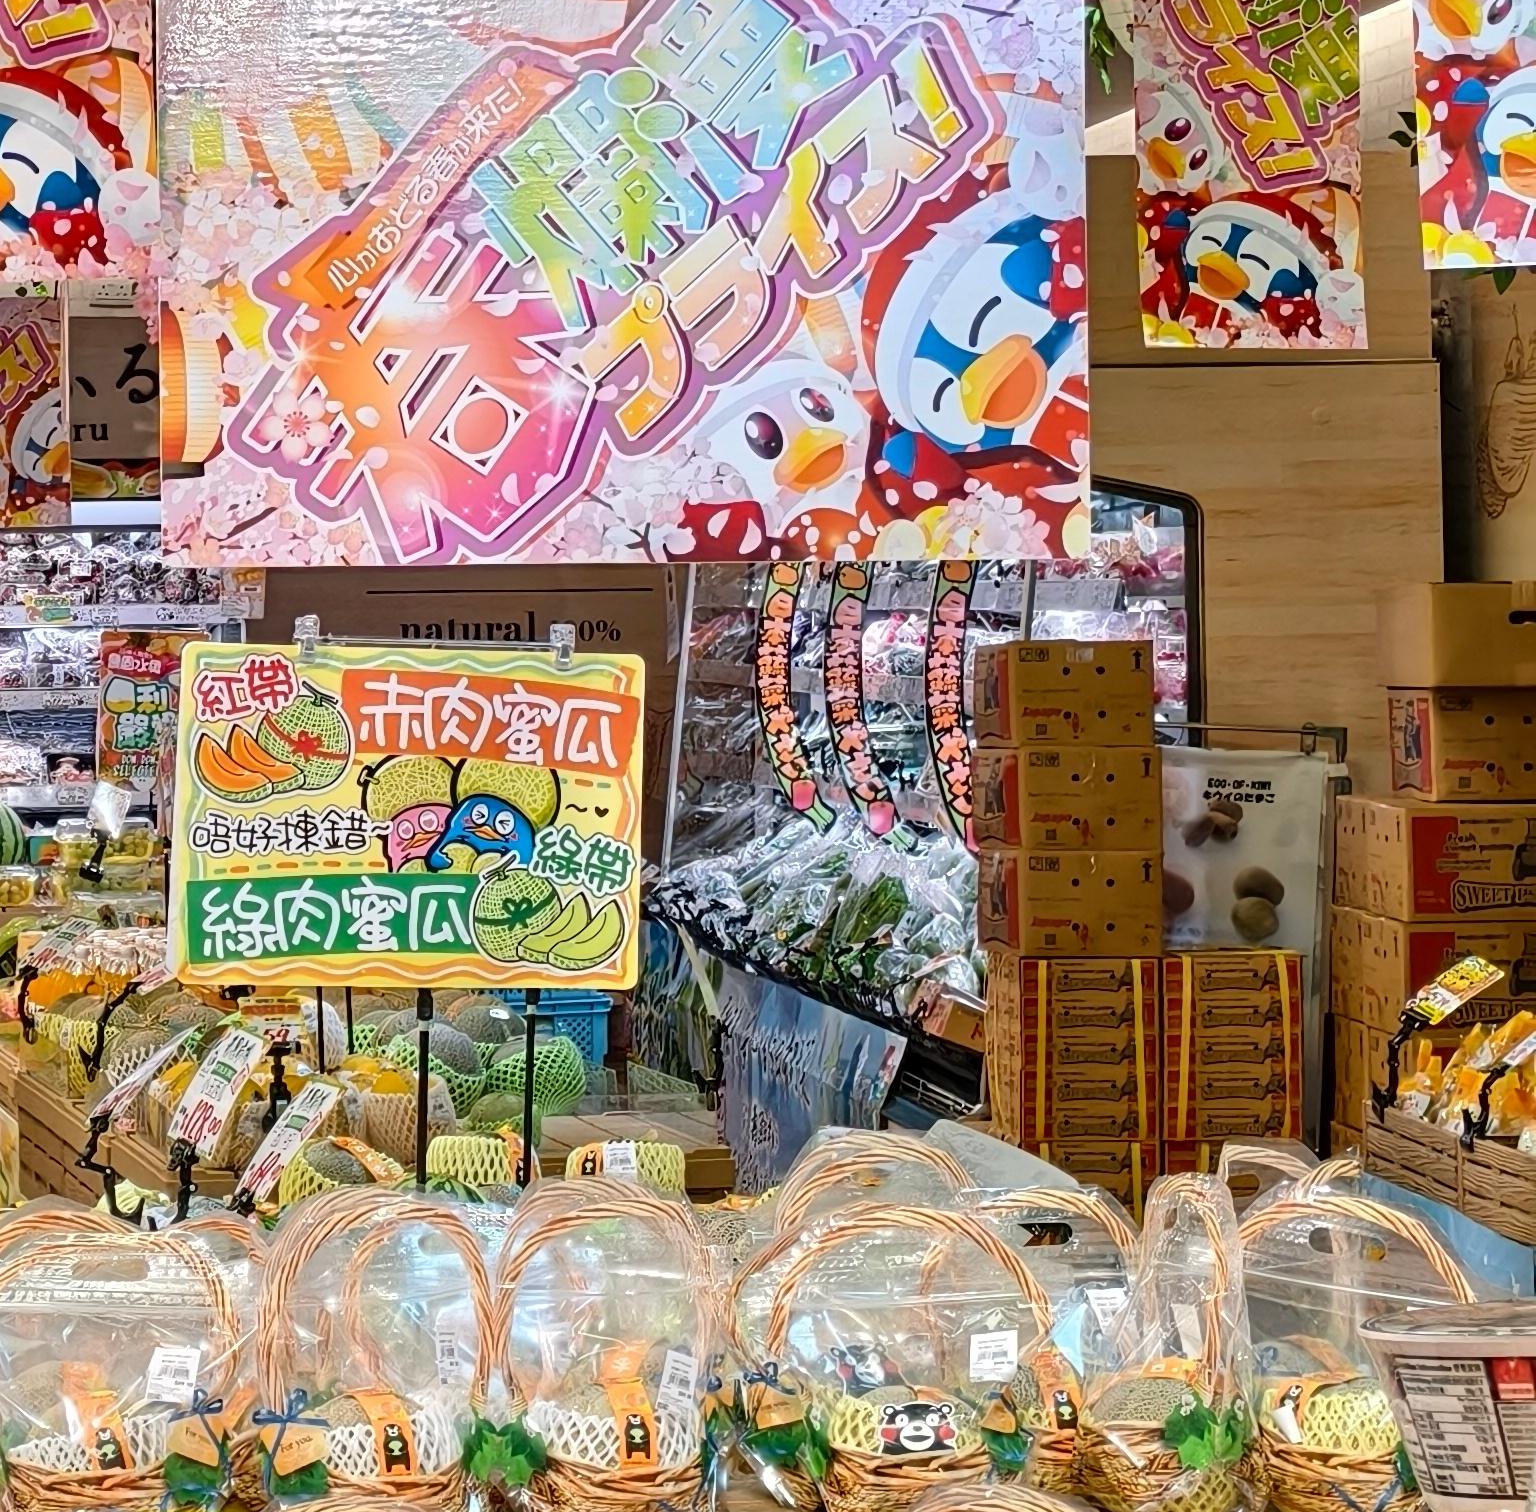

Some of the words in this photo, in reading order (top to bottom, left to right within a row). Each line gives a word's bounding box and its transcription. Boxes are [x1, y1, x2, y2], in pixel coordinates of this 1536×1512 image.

[324, 74, 528, 298] 心がおどる春が来た!
[399, 609, 537, 643] natural
[358, 672, 626, 768] 赤肉蜜瓜
[1456, 883, 1512, 906] SWEET
